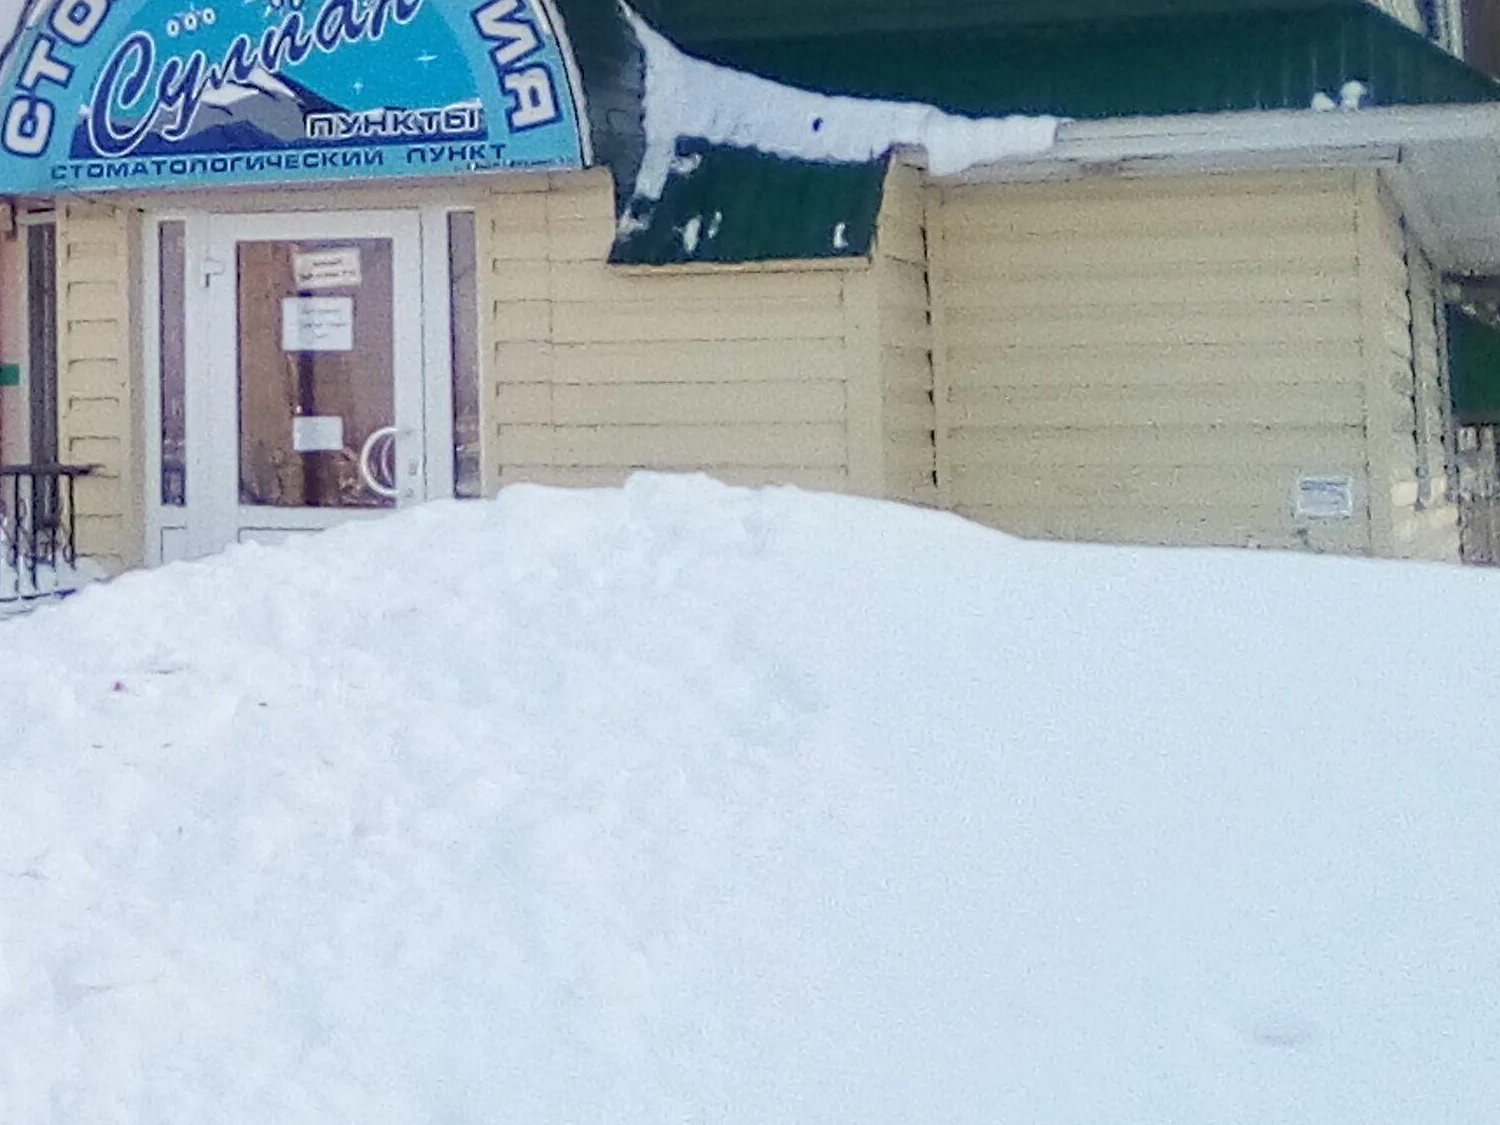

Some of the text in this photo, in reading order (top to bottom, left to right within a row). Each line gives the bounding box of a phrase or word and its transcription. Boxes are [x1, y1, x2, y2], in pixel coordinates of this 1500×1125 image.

[305, 106, 483, 139] ПУНКТЫ
[51, 148, 384, 181] СТОМАТОЛОГИЧЕСКИЙ
[405, 142, 507, 166] ПУНКТ
